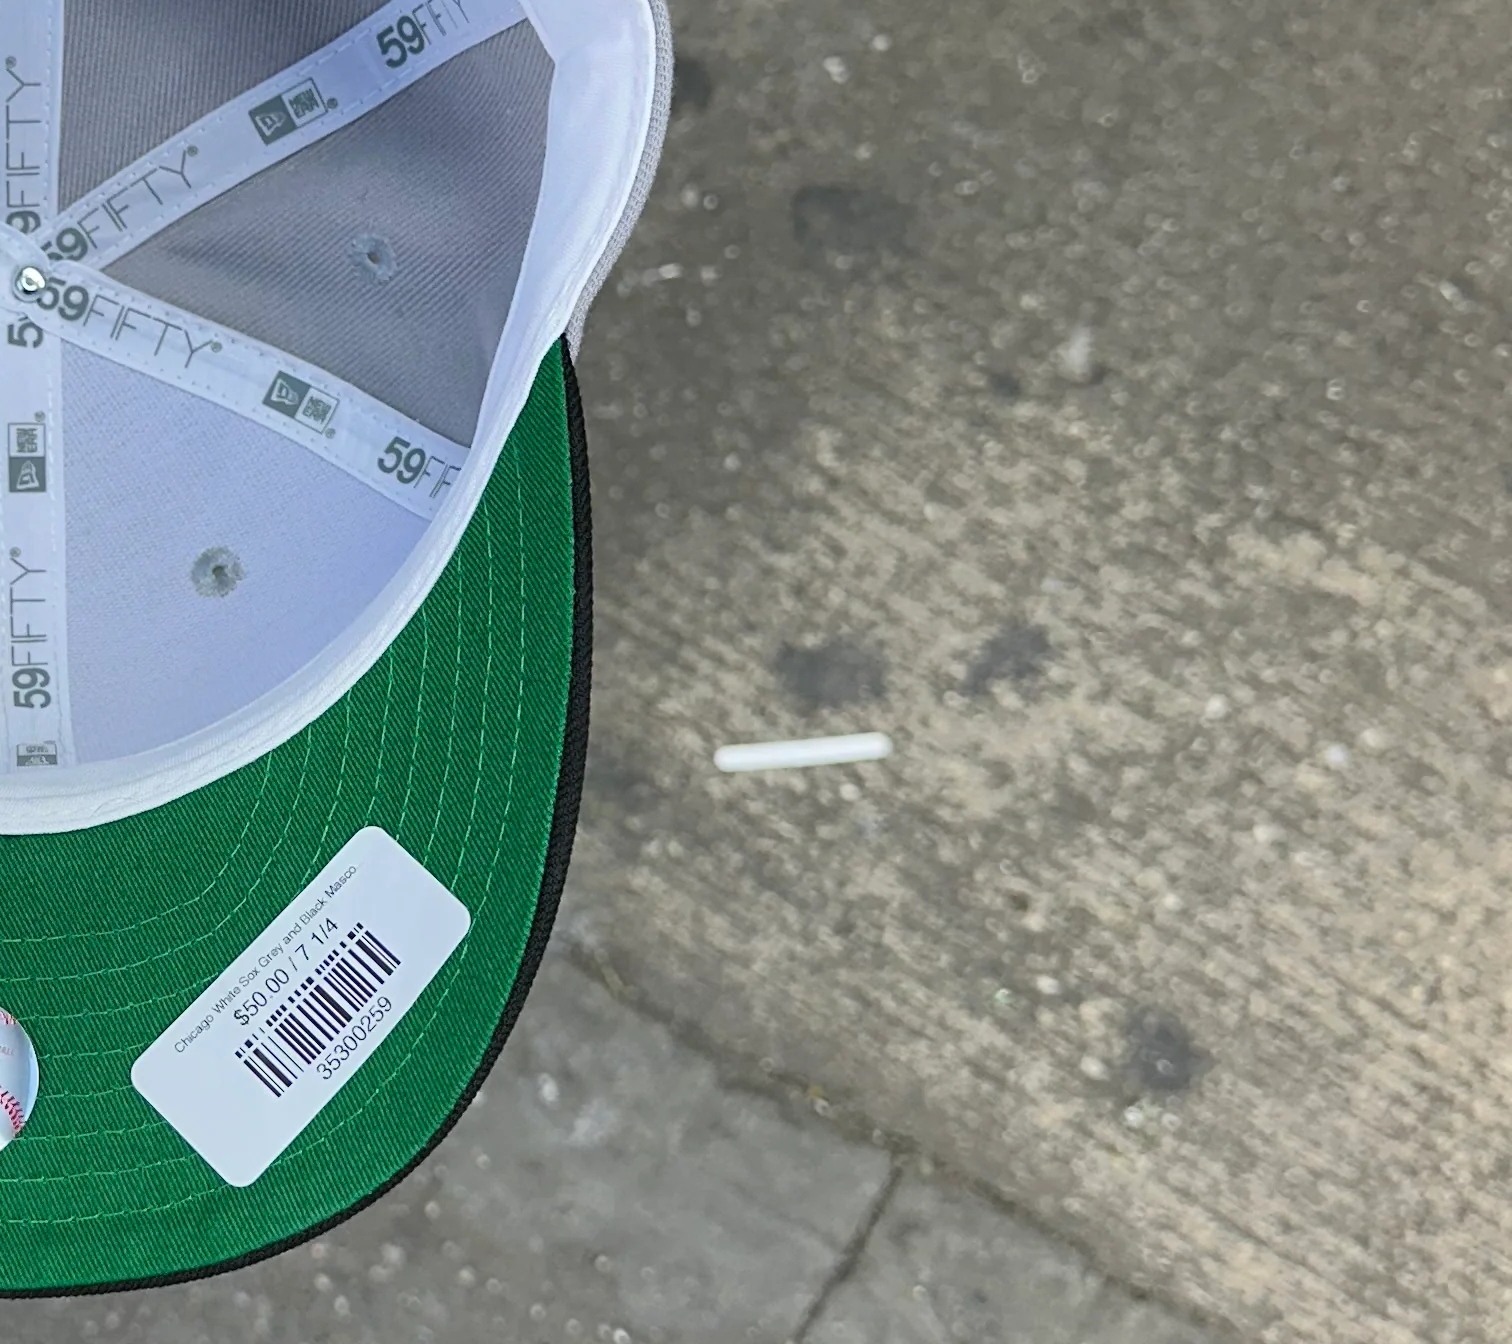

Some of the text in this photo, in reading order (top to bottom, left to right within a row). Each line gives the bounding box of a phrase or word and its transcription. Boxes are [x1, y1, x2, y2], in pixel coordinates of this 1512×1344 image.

[5, 68, 42, 233] 9FIFTY
[10, 558, 52, 710] 59FIFTY
[174, 1013, 215, 1054] Chicago
[213, 984, 243, 1015] White
[238, 966, 261, 989] Sox
[257, 942, 285, 969] Grey
[282, 923, 303, 946] and
[299, 897, 328, 925] Black
[233, 968, 291, 1027] $50.00
[294, 944, 310, 963] 7
[311, 917, 339, 947] 1/4
[316, 995, 393, 1081] 35300259
